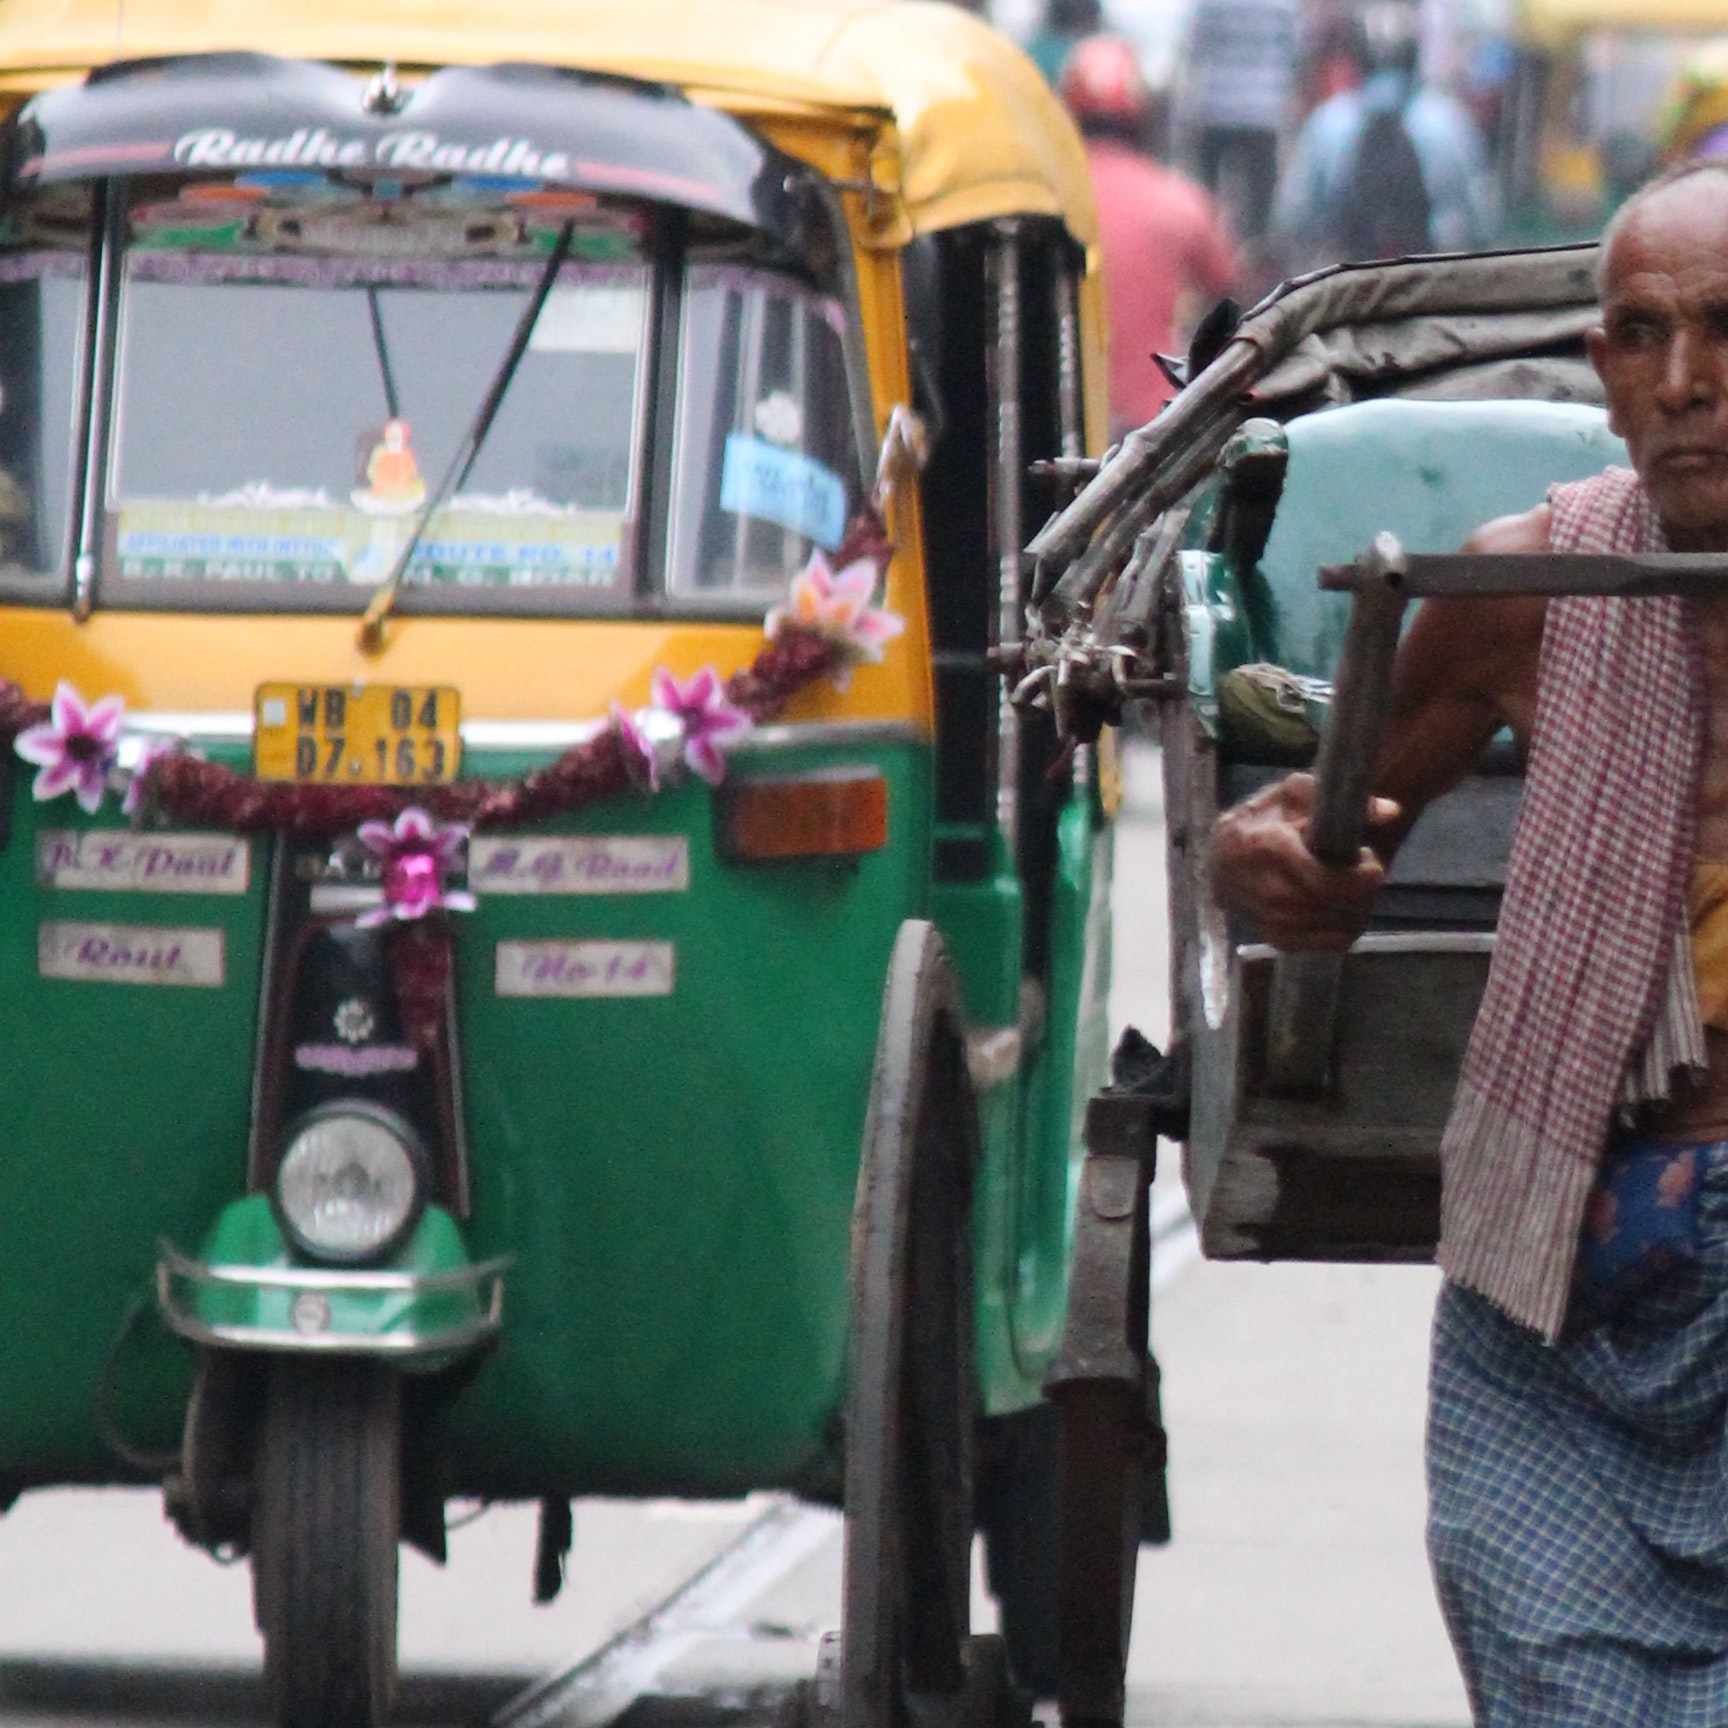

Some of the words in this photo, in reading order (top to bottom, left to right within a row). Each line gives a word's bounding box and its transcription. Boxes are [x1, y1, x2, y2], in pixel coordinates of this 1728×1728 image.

[174, 128, 369, 168] Radhe
[375, 131, 570, 178] Radhe
[299, 688, 346, 727] WB
[391, 689, 438, 729] 04
